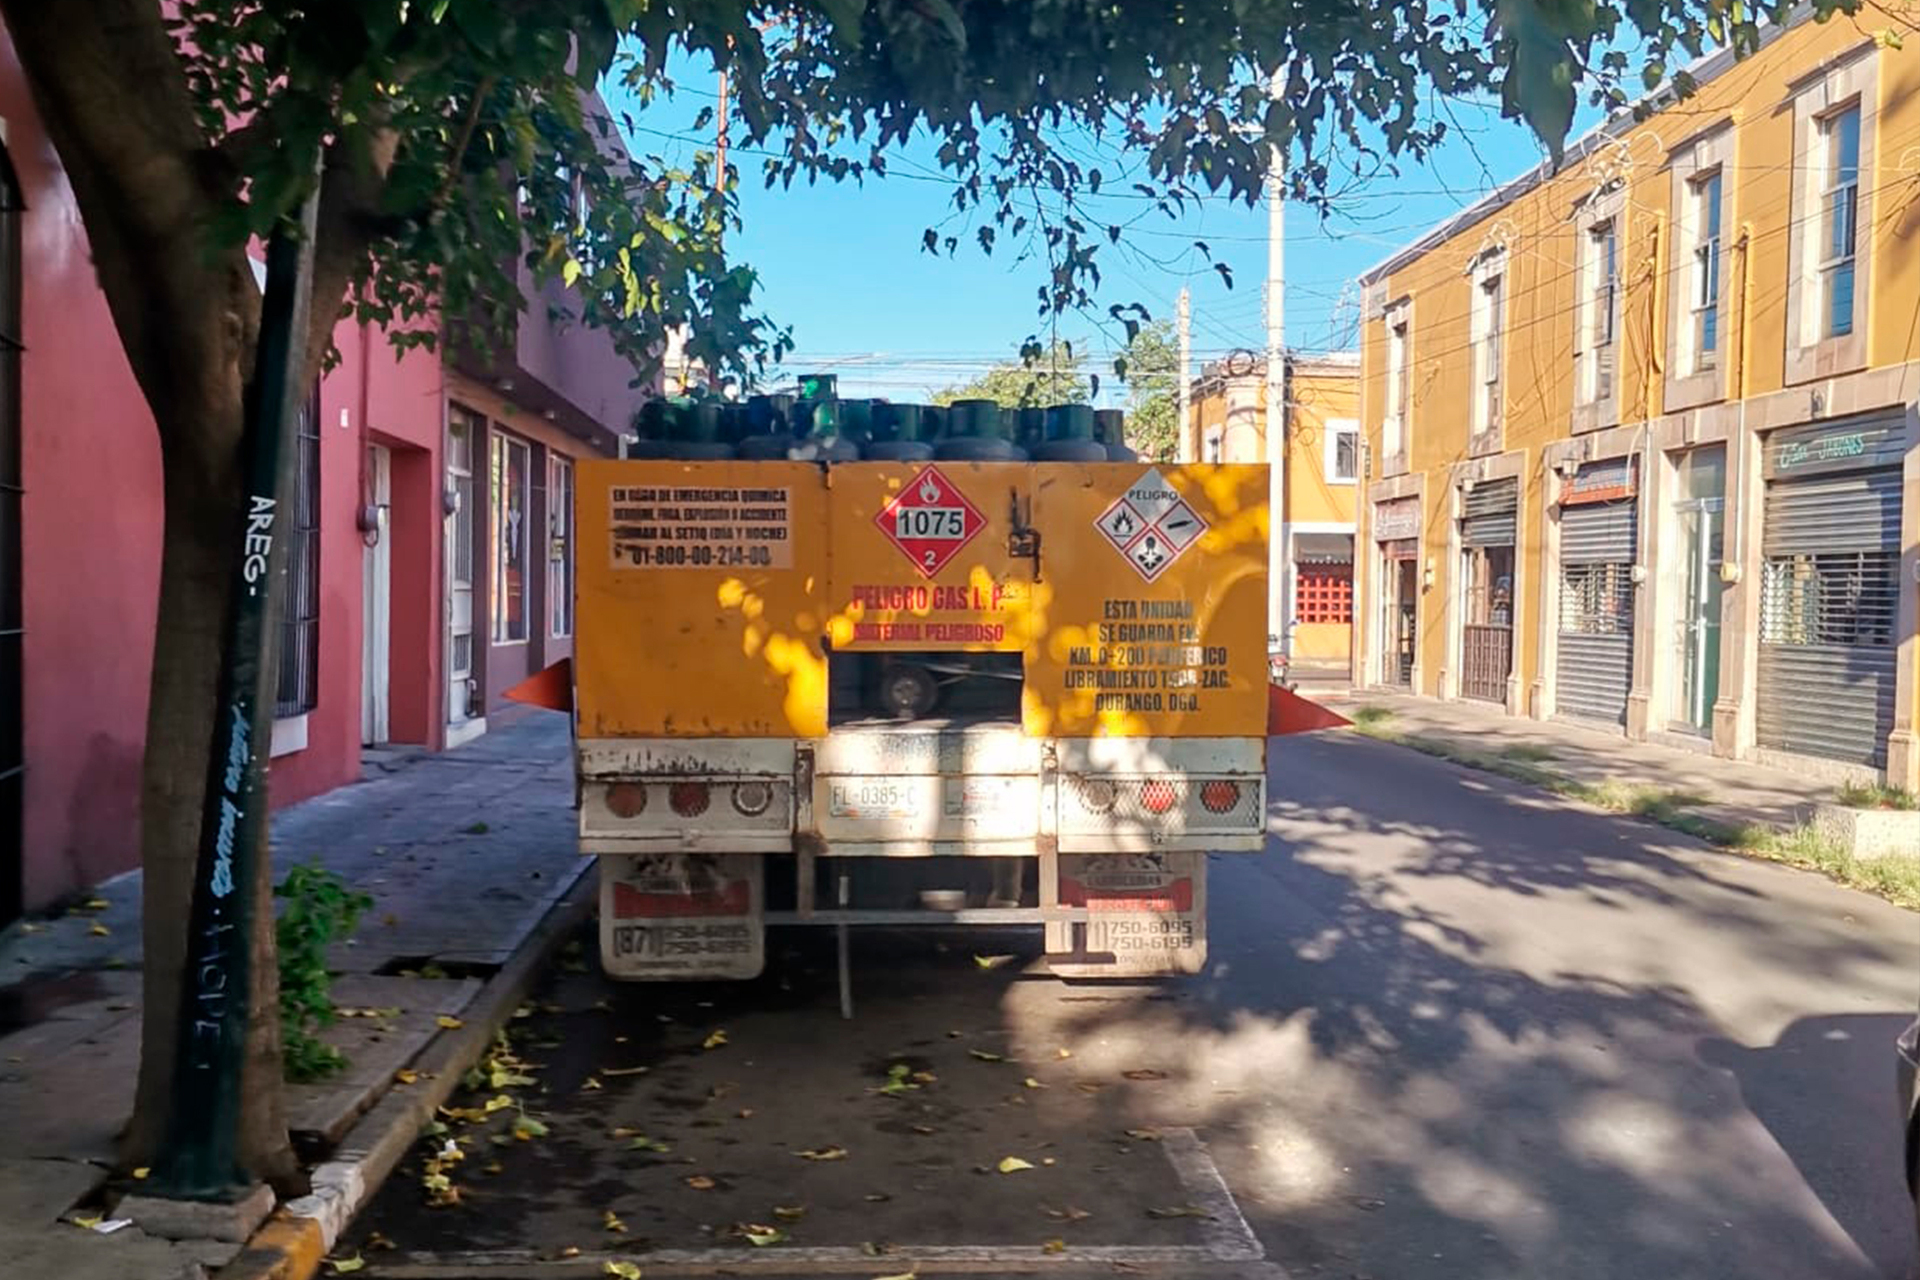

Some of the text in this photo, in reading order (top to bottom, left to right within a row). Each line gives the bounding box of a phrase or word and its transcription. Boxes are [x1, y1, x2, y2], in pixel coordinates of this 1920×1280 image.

[658, 489, 671, 502] DE
[673, 489, 739, 502] EMERGENCIA
[1128, 489, 1178, 501] PELIGRO
[901, 511, 964, 536] 1075
[660, 527, 673, 540] AL
[675, 527, 708, 541] SETIQ
[735, 527, 743, 540] Y
[924, 551, 936, 566] 2
[853, 585, 928, 610] PELIGRO
[933, 585, 969, 610] GAS
[1105, 599, 1193, 620] ESTA UNIDAD
[855, 622, 1005, 643] MATERIAL PELIGROSO
[1099, 623, 1115, 643] SE
[1118, 622, 1175, 643] GUARDA
[1069, 646, 1096, 666] KM.
[1064, 669, 1158, 689] LIBRAMIENTO
[833, 785, 918, 806] FL-0385-C
[1110, 920, 1193, 935] 750-6095
[1111, 935, 1193, 950] 750-6195
